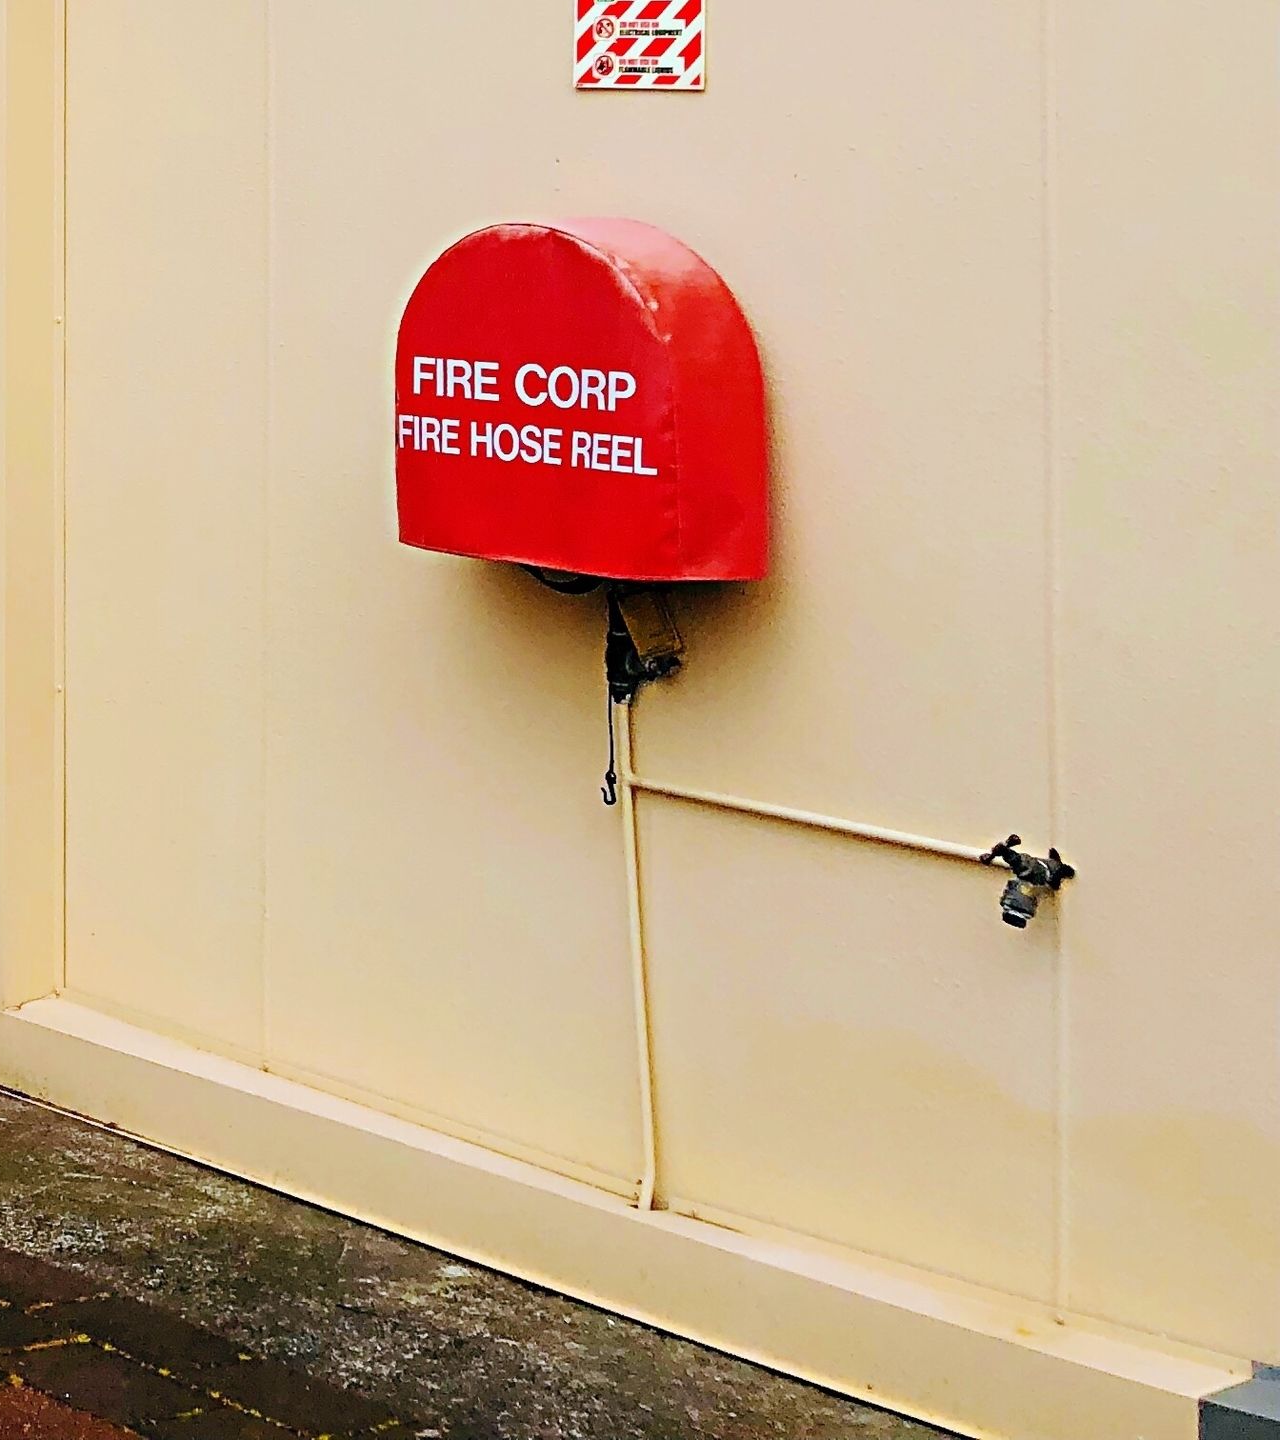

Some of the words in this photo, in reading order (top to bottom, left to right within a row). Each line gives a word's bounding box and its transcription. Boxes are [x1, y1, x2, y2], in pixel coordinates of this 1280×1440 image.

[413, 356, 499, 401] FIRE
[515, 363, 636, 411] CORP
[398, 414, 460, 455] FIRE
[471, 422, 562, 465] HOSE
[571, 431, 658, 475] REEL
